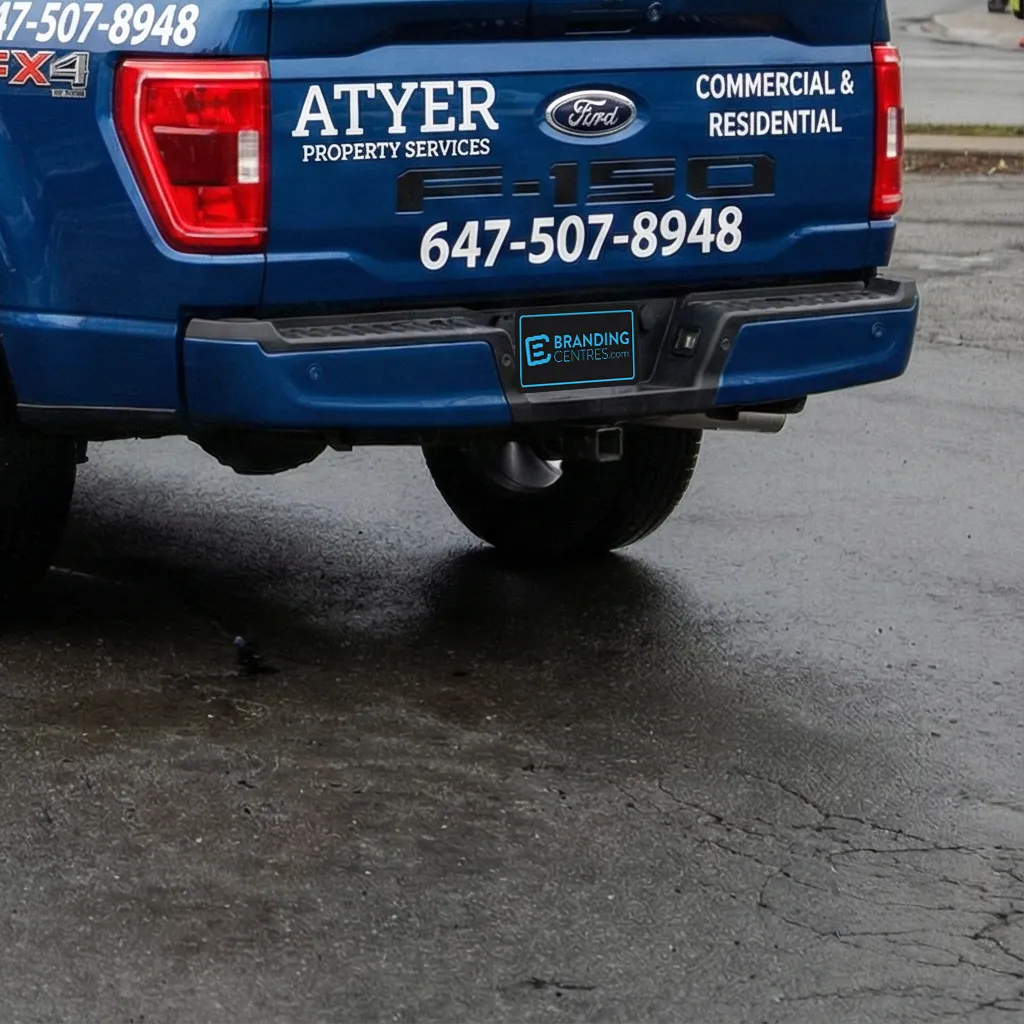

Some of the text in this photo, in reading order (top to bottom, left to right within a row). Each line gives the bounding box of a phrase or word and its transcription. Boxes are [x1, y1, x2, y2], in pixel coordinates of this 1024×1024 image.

[696, 69, 854, 99] COMMERCIAL &
[291, 79, 499, 137] ATYER
[568, 98, 619, 127] Ford
[709, 109, 843, 137] RESIDENTIAL
[302, 138, 491, 162] PROPERTY SERVICES
[395, 154, 776, 215] F-150
[420, 206, 743, 270] 647-507-8948
[553, 330, 631, 350] BRANDING
[553, 347, 630, 364] CENTRES.com
